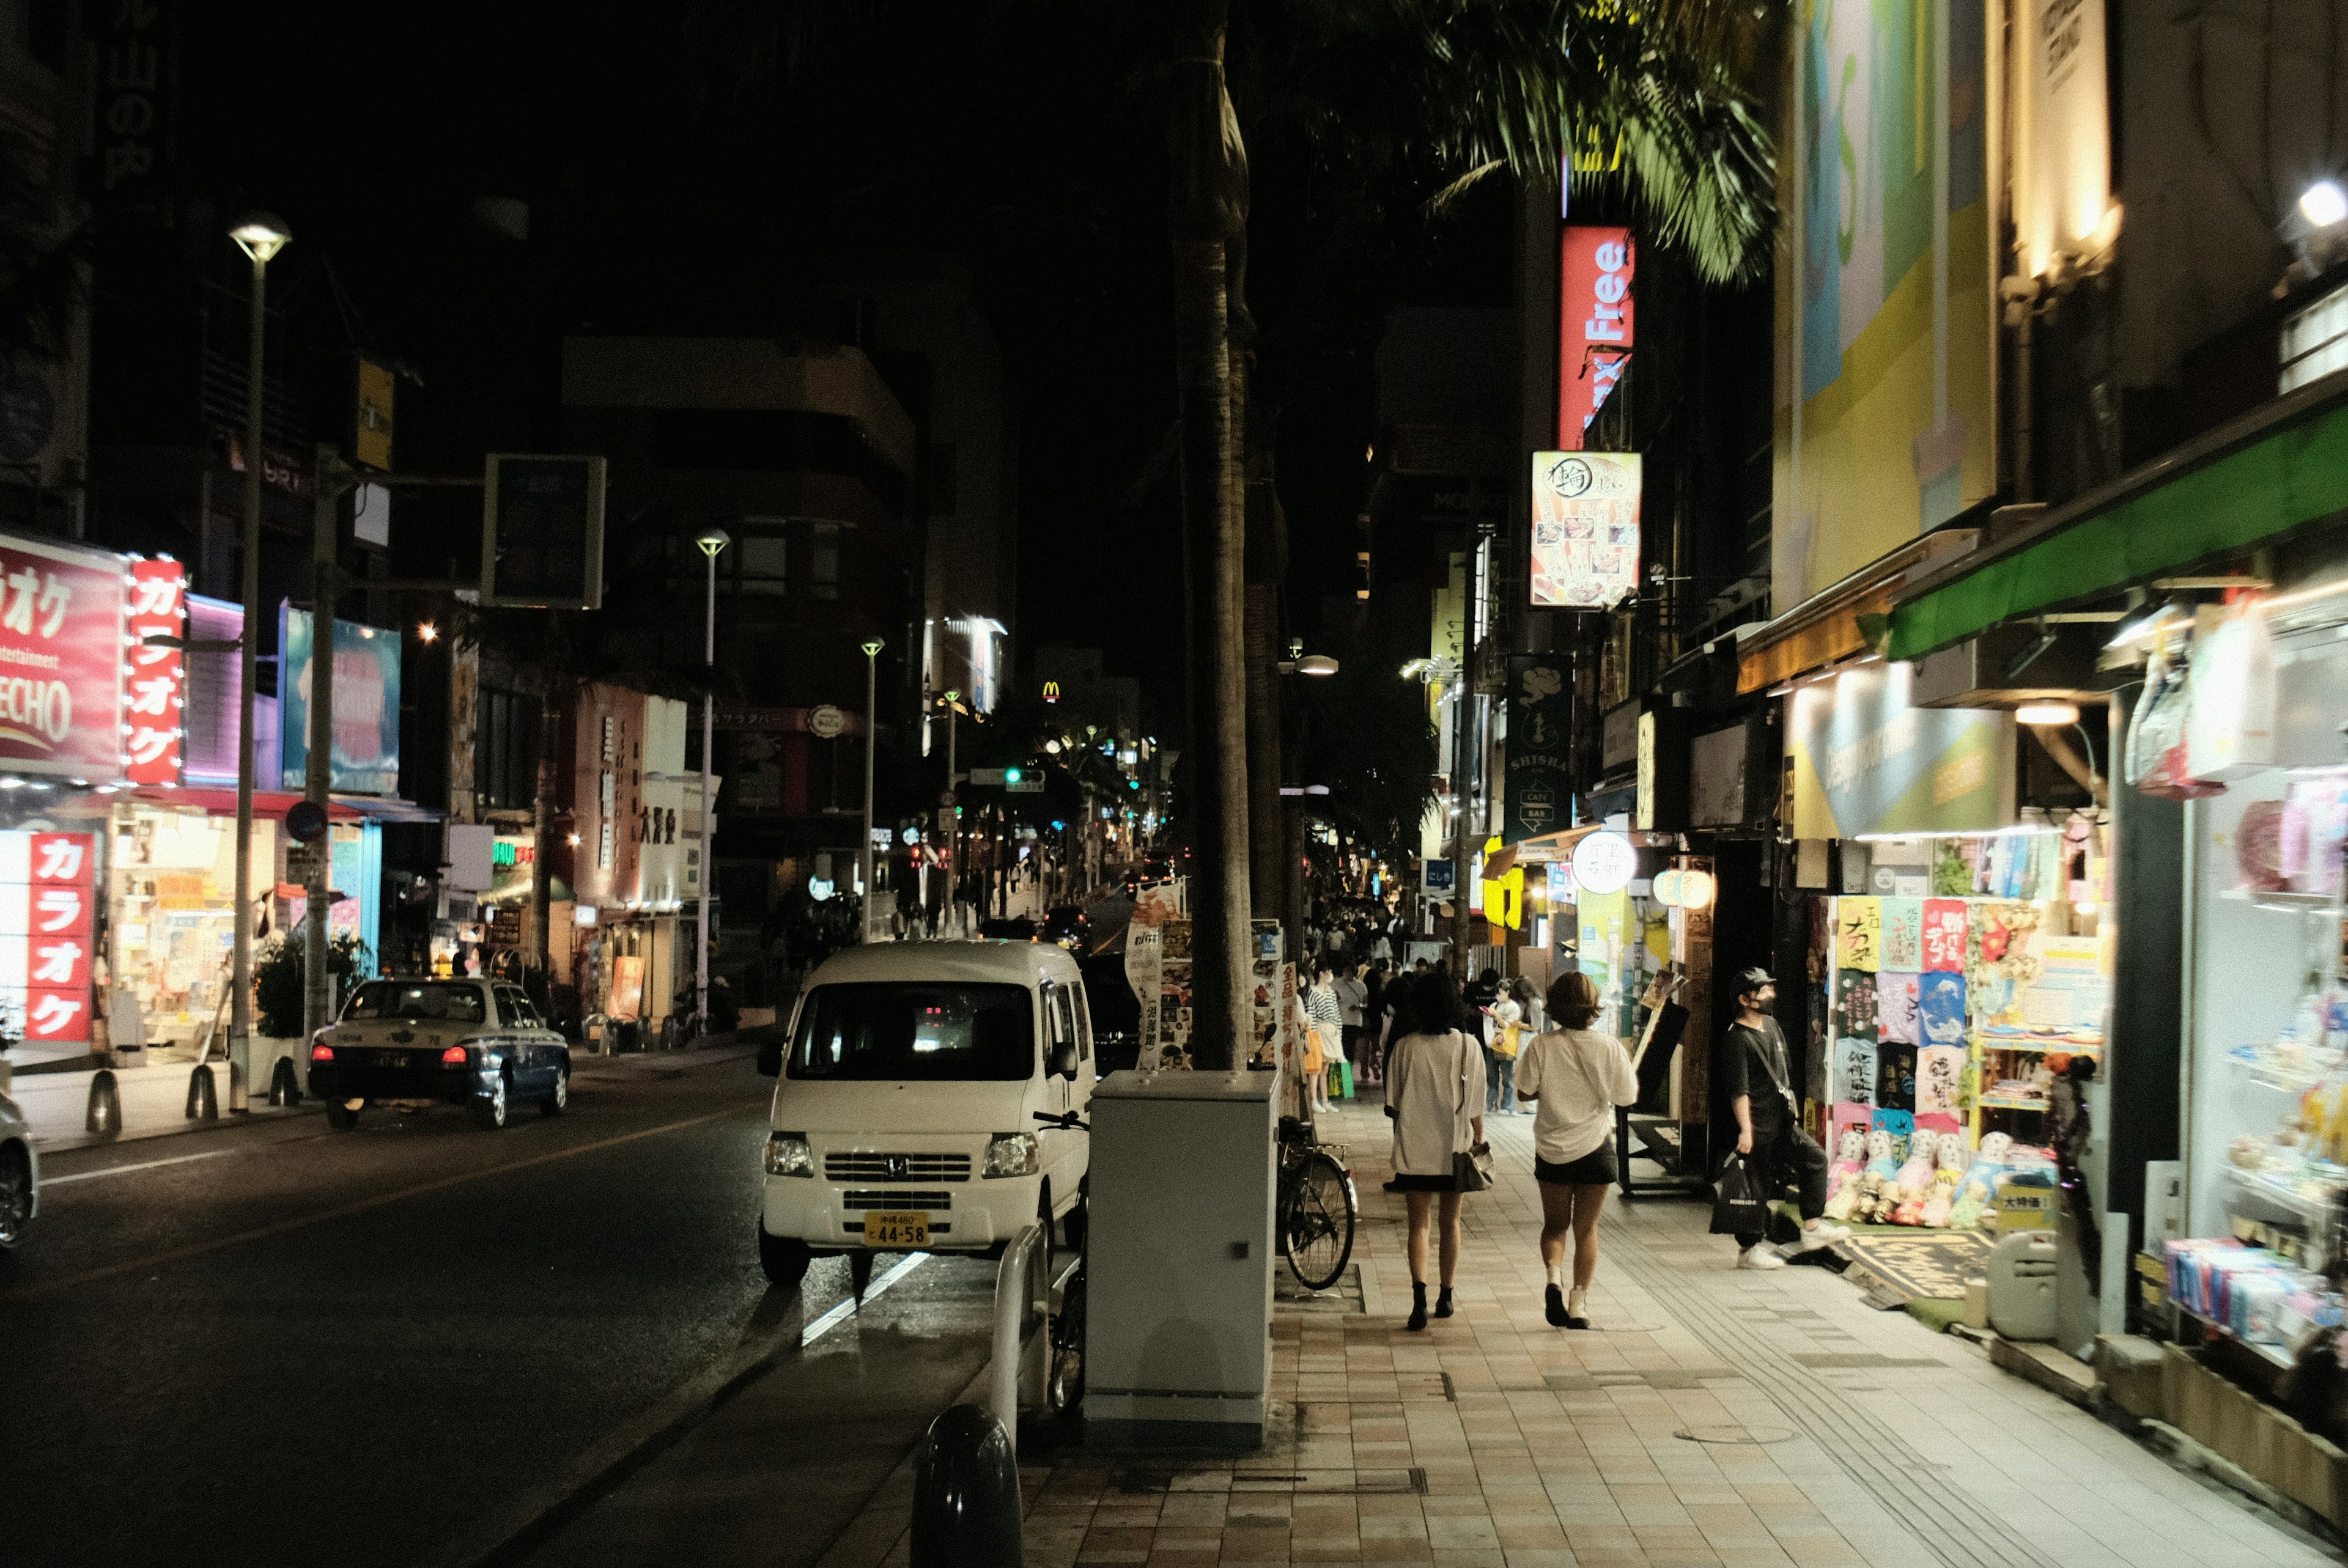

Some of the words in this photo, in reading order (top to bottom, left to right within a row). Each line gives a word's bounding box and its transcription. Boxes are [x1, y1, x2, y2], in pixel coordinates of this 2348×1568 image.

[1586, 241, 1625, 340] Free
[0, 561, 72, 639] オケ
[129, 577, 177, 765] カラオケ
[1510, 754, 1567, 772] SHISHA
[33, 838, 84, 1034] カラオケ
[879, 1226, 925, 1243] 44-58
[880, 1216, 897, 1224] 沖縄
[898, 1216, 914, 1224] 480
